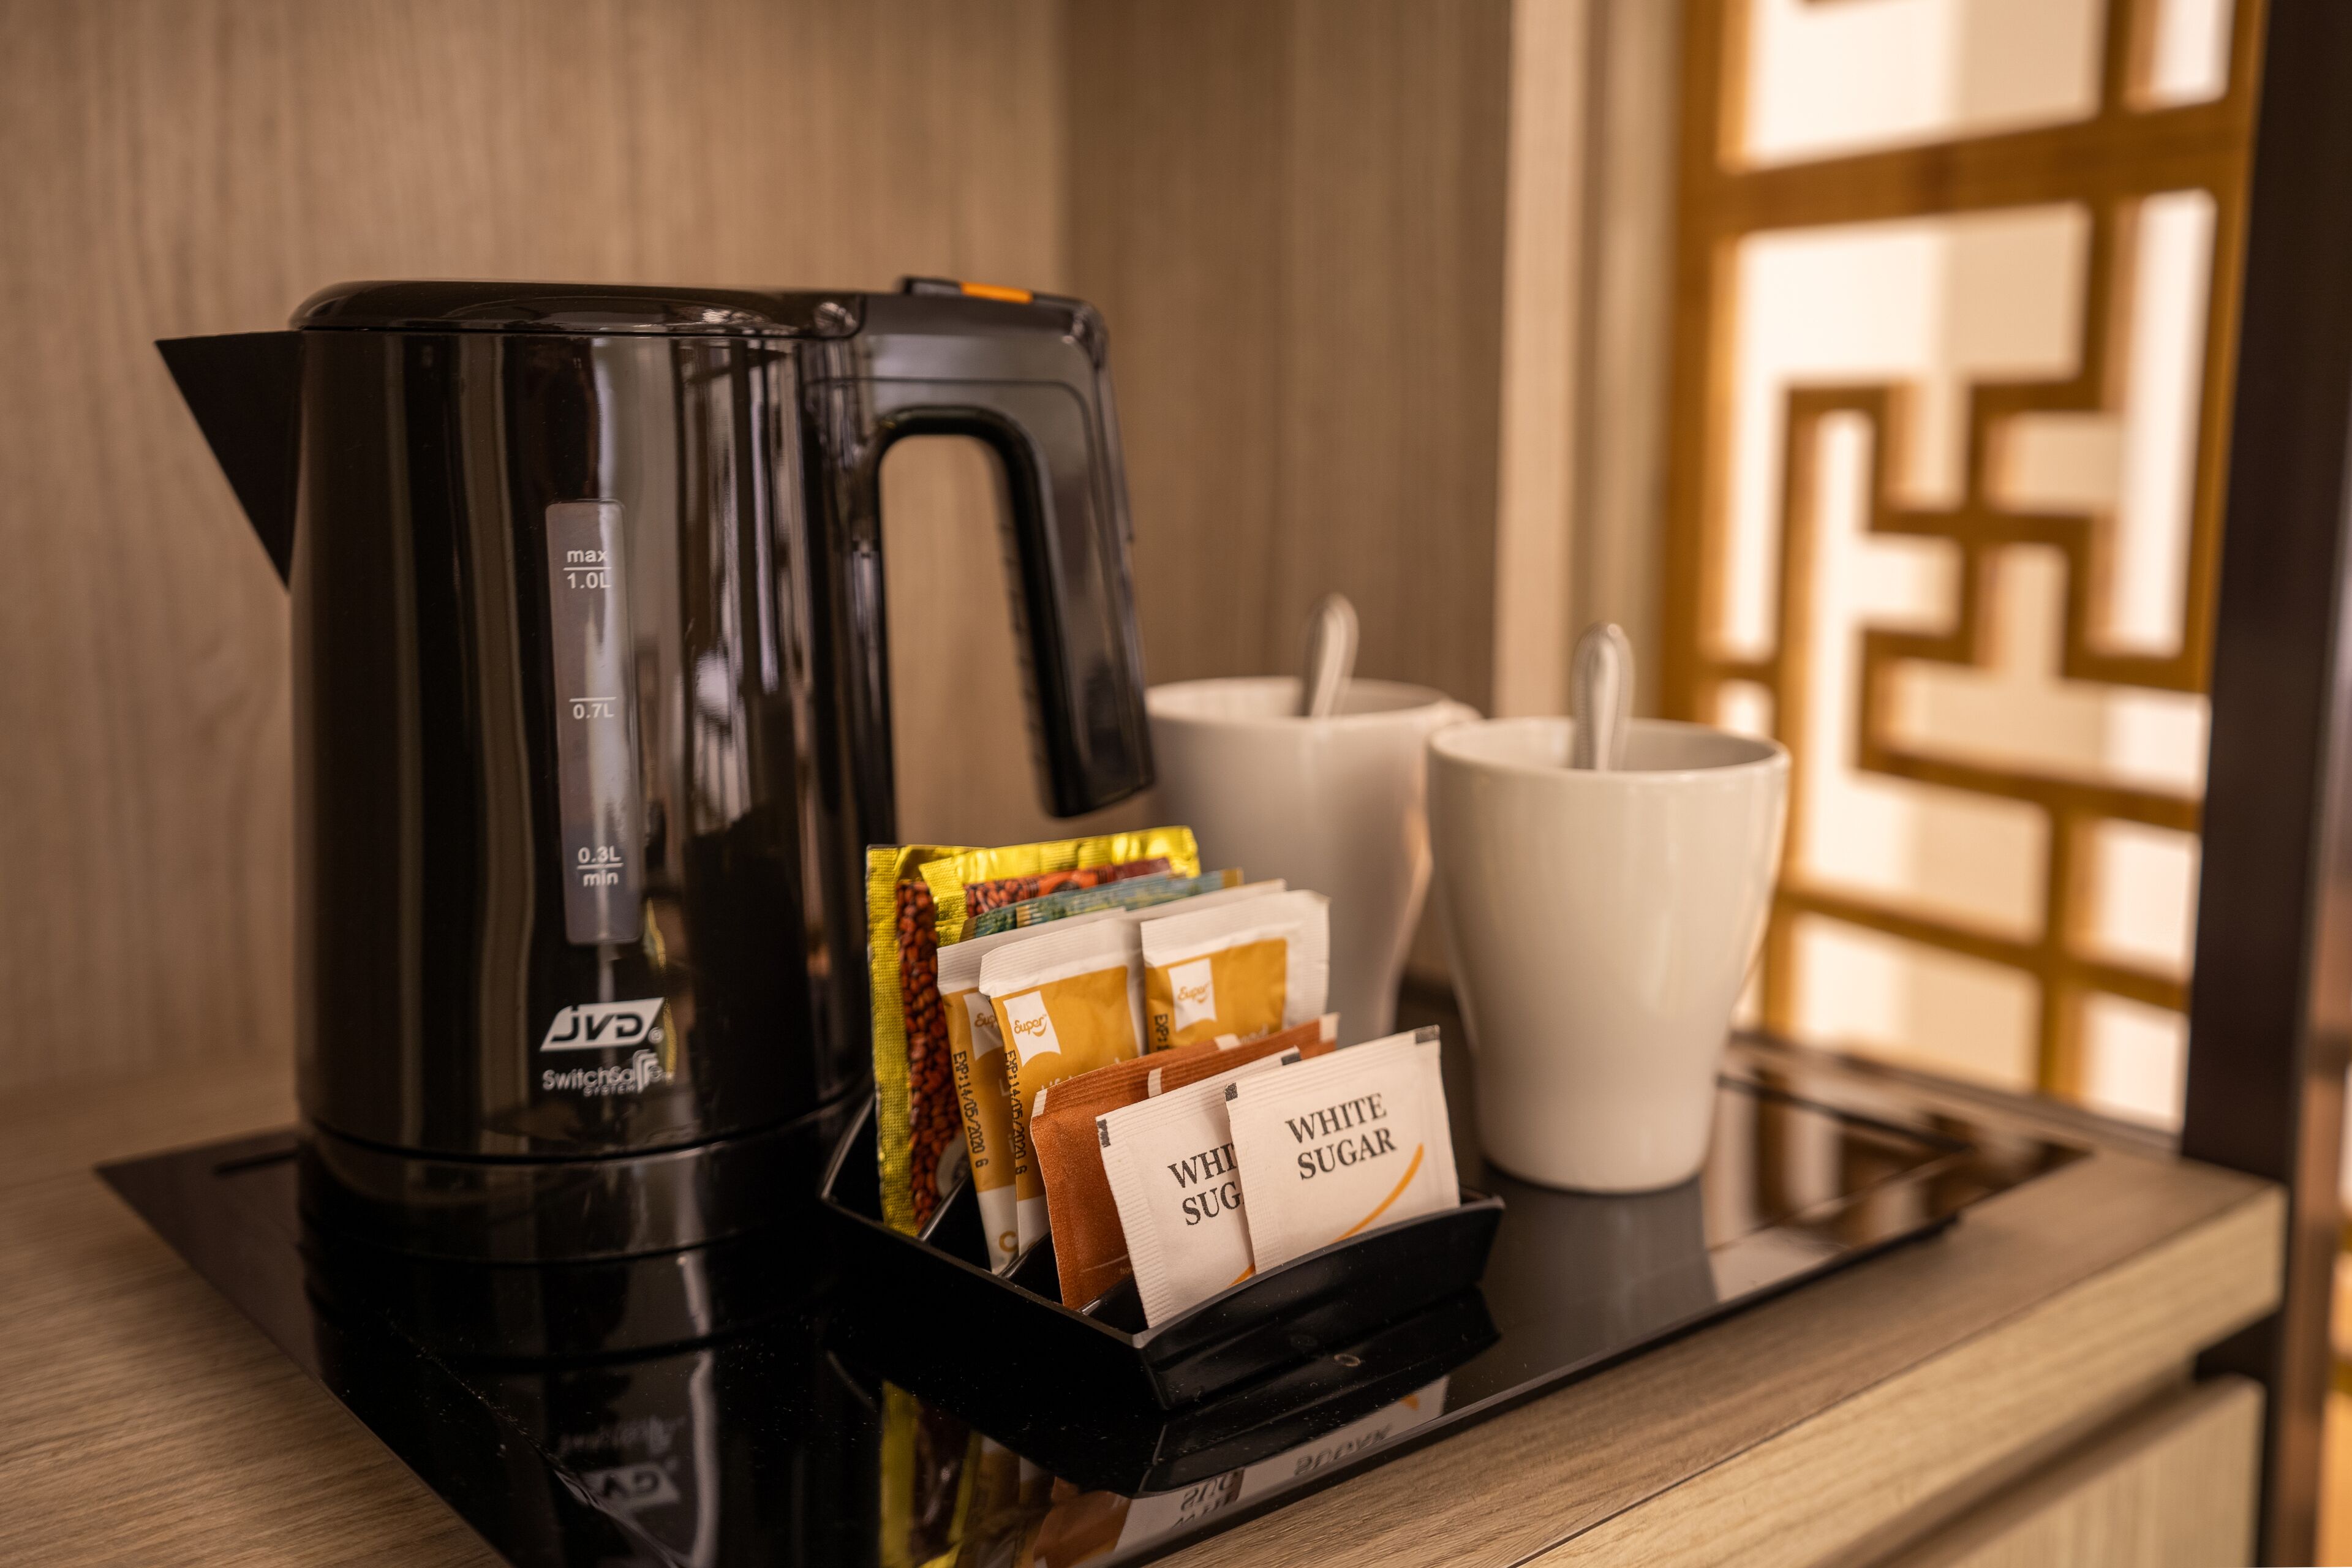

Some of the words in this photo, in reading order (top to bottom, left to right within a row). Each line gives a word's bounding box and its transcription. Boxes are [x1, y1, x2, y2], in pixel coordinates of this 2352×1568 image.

[567, 549, 608, 563] max
[567, 571, 612, 589] 1.0L
[573, 703, 615, 720] 0.7L
[578, 846, 622, 864] 0.3L
[583, 870, 619, 887] min
[1177, 982, 1210, 1001] Super
[549, 1005, 645, 1042] JVD
[1014, 1016, 1045, 1035] Super
[953, 1050, 985, 1154] EXP:14/05/2020
[1284, 1092, 1387, 1144] WHITE
[1297, 1127, 1397, 1180] SUGAR
[1167, 1142, 1237, 1188] WHI
[1182, 1181, 1245, 1226] SUG
